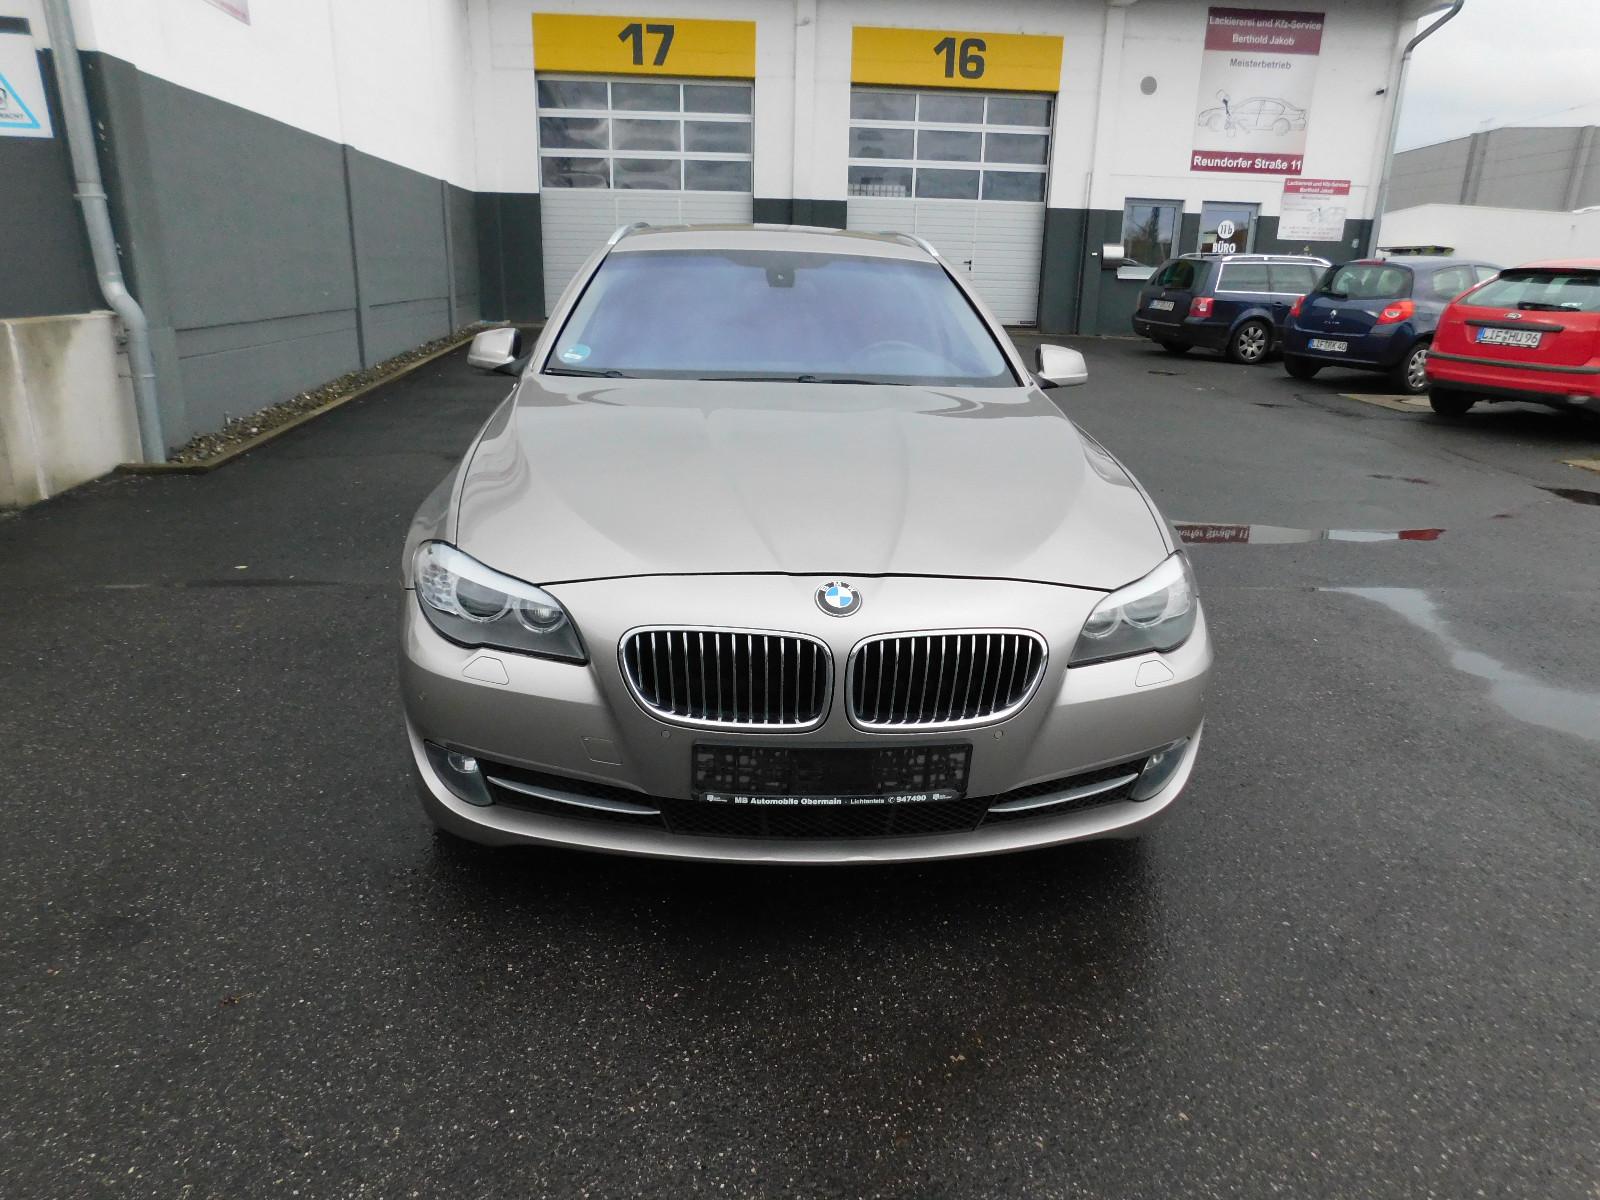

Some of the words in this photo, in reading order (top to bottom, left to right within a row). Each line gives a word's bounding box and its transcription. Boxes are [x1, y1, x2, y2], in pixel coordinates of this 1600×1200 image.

[1256, 19, 1273, 28] und
[618, 23, 675, 66] 17
[1232, 33, 1268, 44] Berthold
[1269, 35, 1295, 46] Jakob
[933, 36, 987, 79] 16
[1229, 58, 1292, 70] Meisterbetrieb
[1193, 155, 1252, 168] Reundorfer
[1254, 158, 1288, 170] Straße
[1290, 160, 1302, 171] 11
[1212, 240, 1237, 253] BÜRO
[734, 796, 749, 804] MB
[751, 797, 799, 805] Automobile
[801, 797, 842, 805] Obermain
[896, 794, 927, 803] 947490
